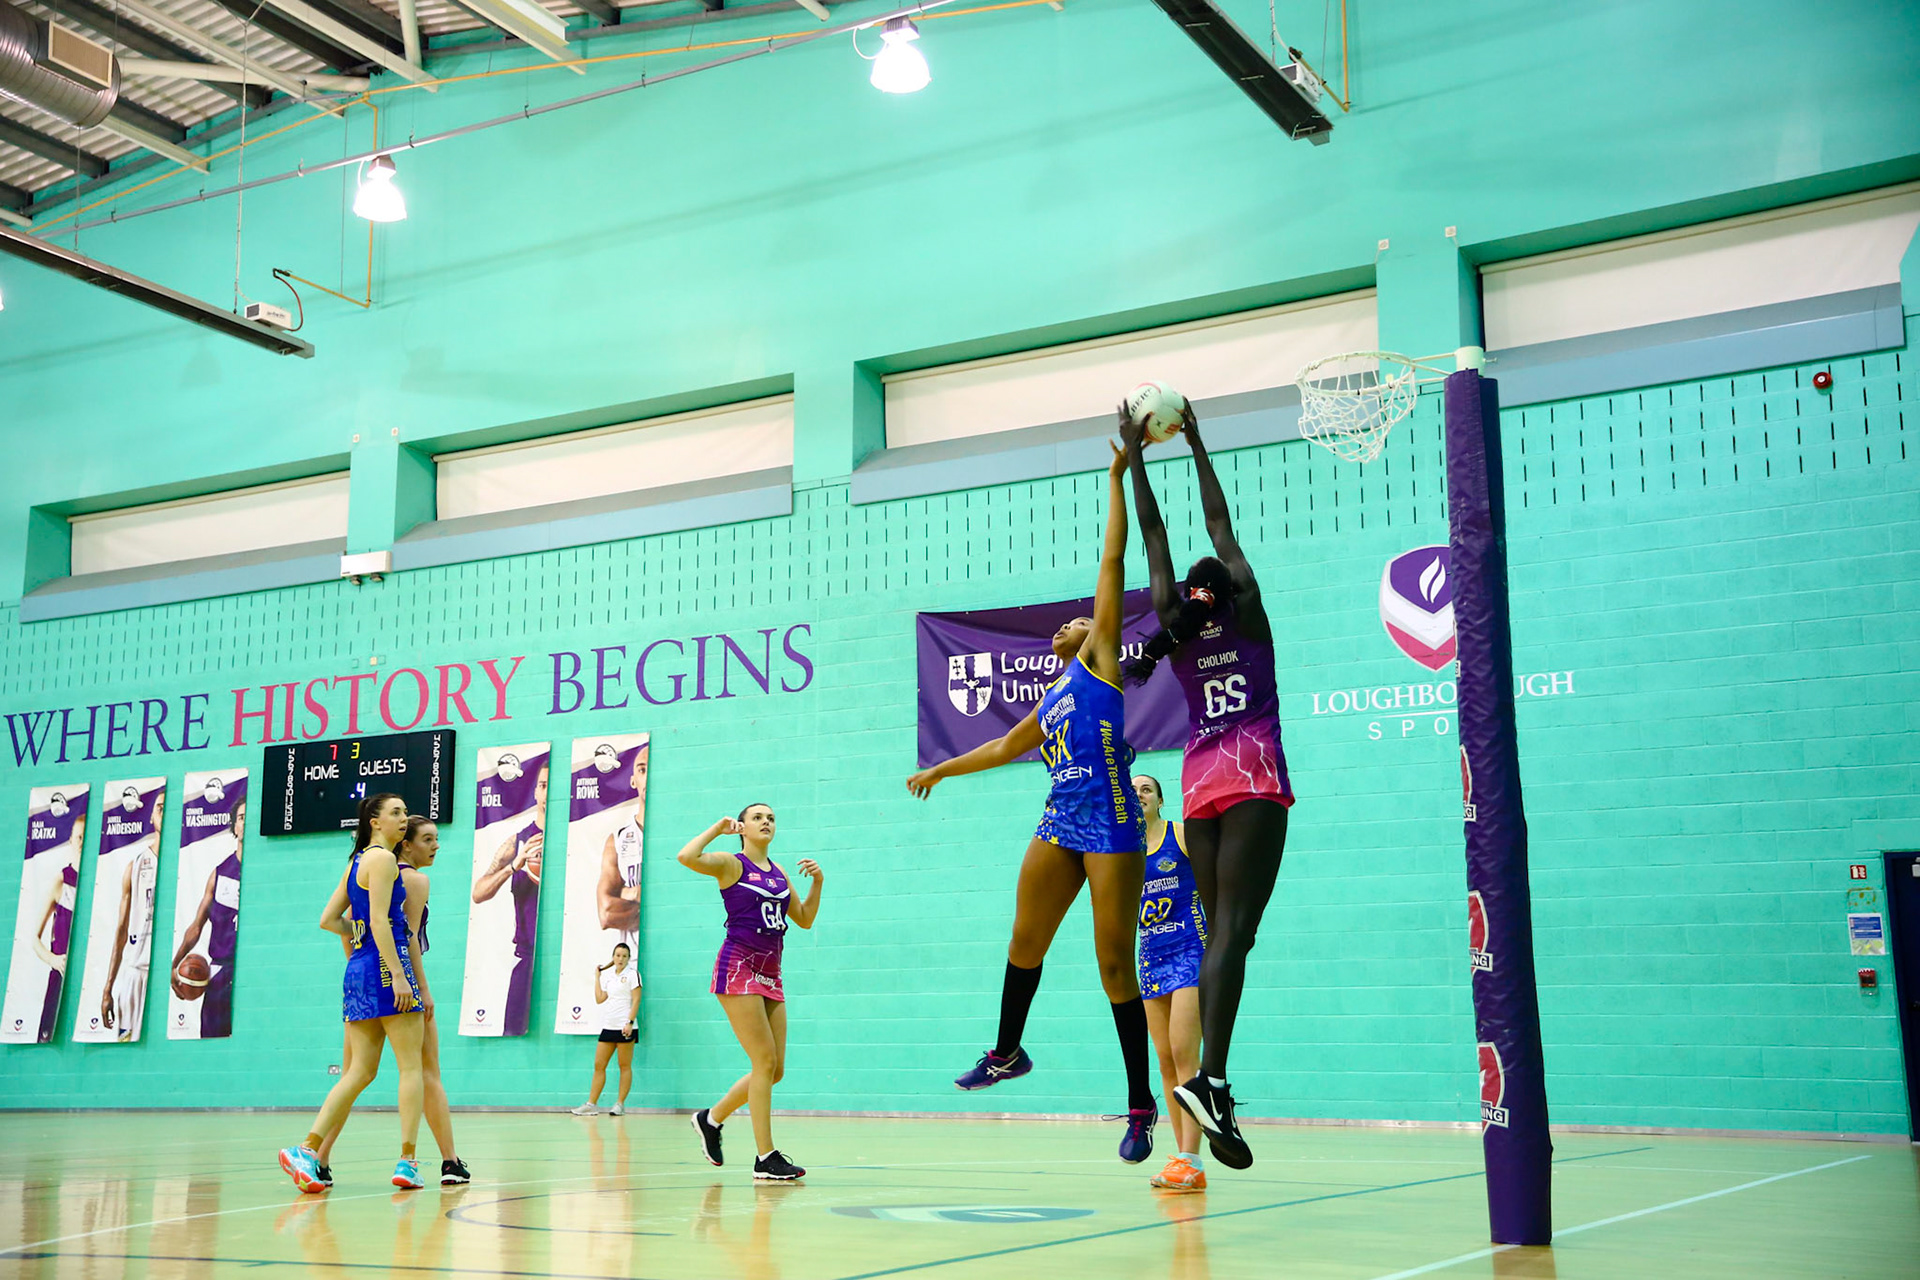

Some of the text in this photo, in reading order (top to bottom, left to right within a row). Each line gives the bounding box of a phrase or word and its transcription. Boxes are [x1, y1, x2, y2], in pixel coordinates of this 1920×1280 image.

[1200, 626, 1223, 637] maxi
[1197, 650, 1239, 670] CHOLHOK
[3, 624, 814, 767] WHERE HISTORY BEGINS
[1203, 674, 1247, 719] GS
[1045, 693, 1075, 724] SPORTING
[329, 742, 360, 760] 7 3
[1040, 719, 1073, 768] GK
[304, 758, 406, 781] HOME GUESTS
[1099, 719, 1129, 824] #WeAreTeamBath
[481, 793, 502, 807] NOEL
[576, 785, 600, 800] ROWE
[106, 822, 142, 835] ANDERSON
[1145, 876, 1179, 889] SPORTING
[761, 901, 786, 930] GA
[1141, 897, 1173, 927] GD
